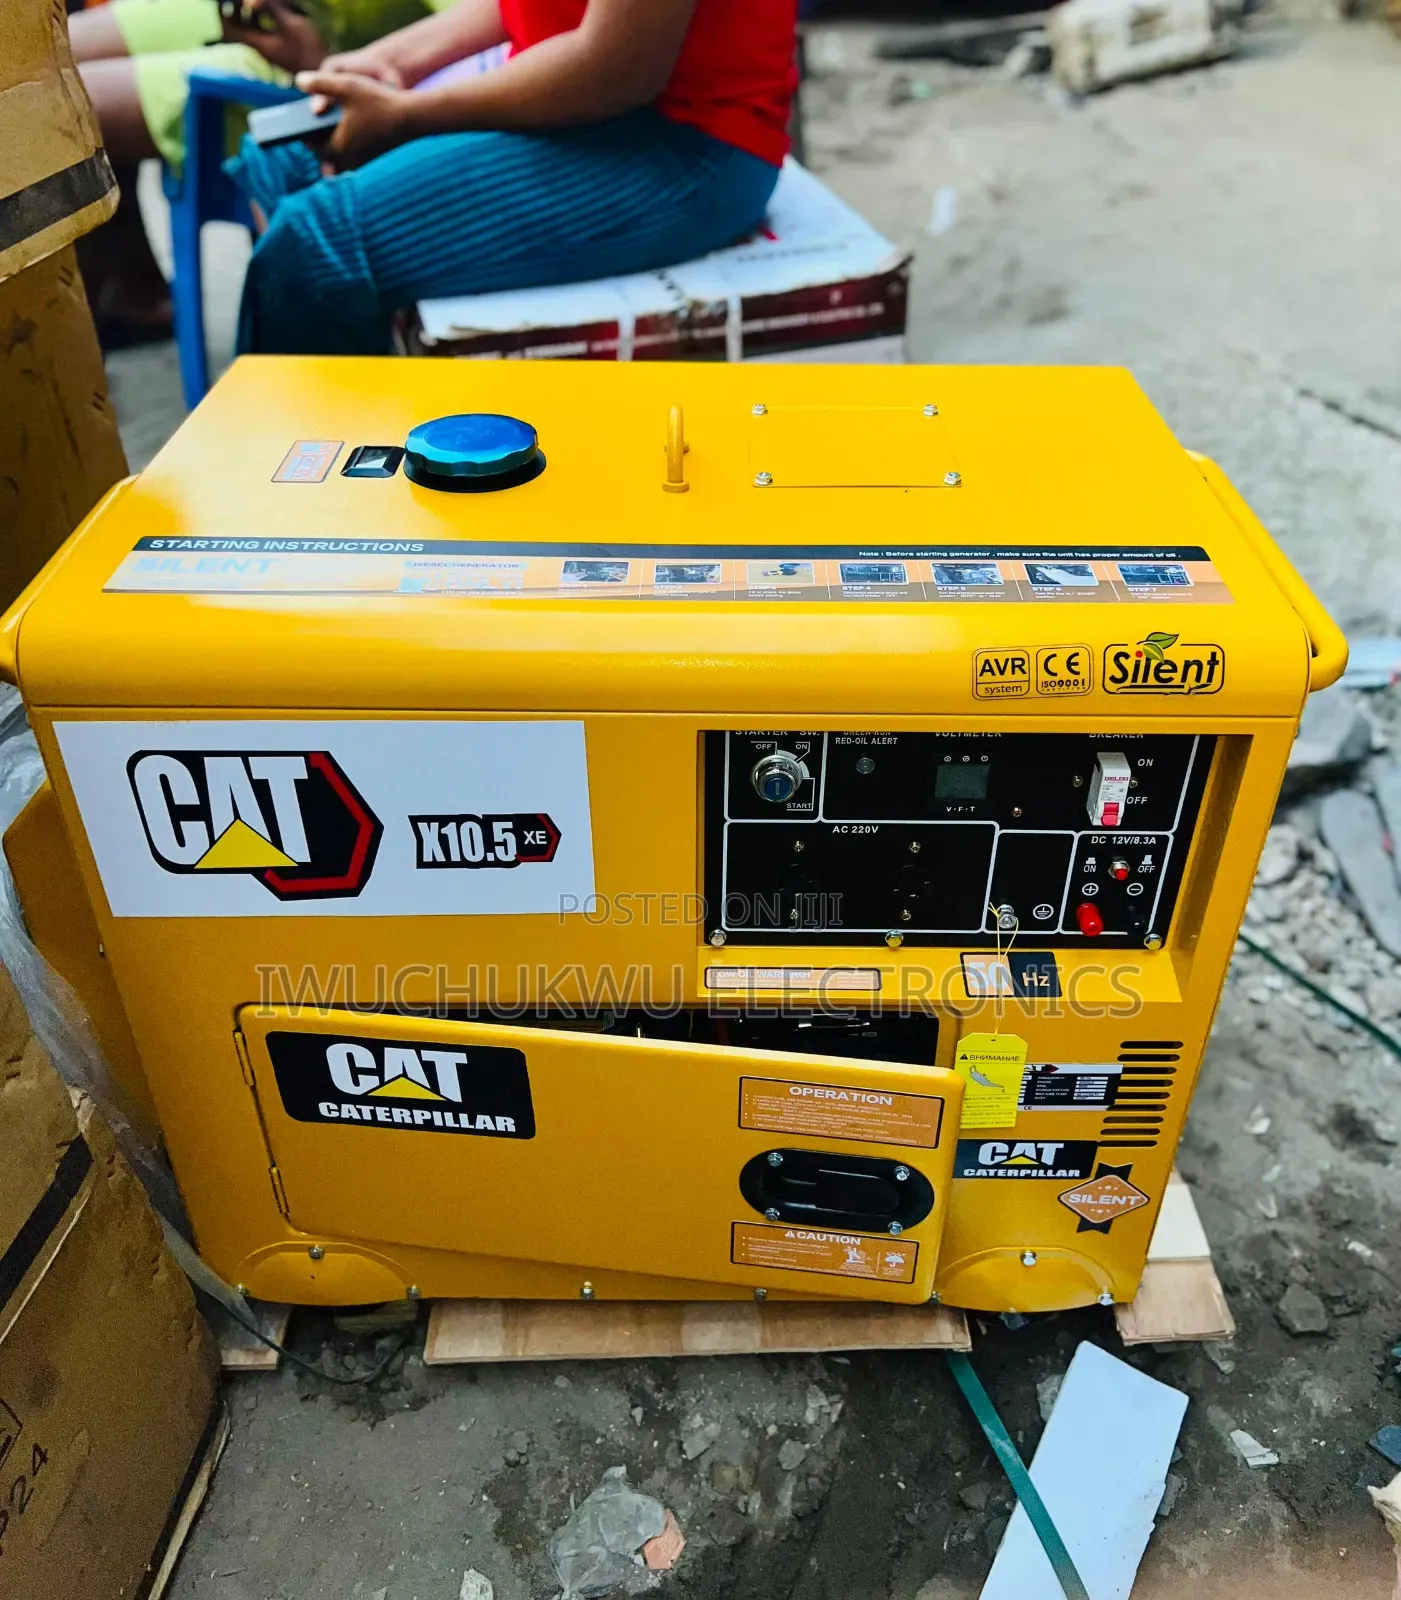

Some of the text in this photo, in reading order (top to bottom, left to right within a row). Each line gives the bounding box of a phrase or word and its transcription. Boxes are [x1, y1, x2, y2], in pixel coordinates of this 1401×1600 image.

[149, 538, 425, 553] STARTING INSTRUCTIONS
[134, 556, 281, 574] SILENT
[979, 657, 1027, 677] AVR
[1109, 650, 1219, 684] Silent
[985, 685, 1022, 695] system
[1041, 678, 1085, 688] ISO9001
[835, 737, 898, 745] RED-OIL ALERT
[1137, 758, 1153, 767] ON
[1126, 796, 1148, 805] OFF
[133, 754, 312, 865] CAT
[832, 825, 879, 834] AC 220V
[417, 821, 547, 863] X10.5 XE
[1091, 836, 1157, 845] DC 12V/8.3A
[1083, 864, 1097, 873] ON
[1137, 865, 1156, 873] OFF
[1022, 972, 1051, 987] Hz
[325, 1042, 468, 1103] CAT
[789, 1086, 893, 1106] OPERATION
[318, 1102, 516, 1132] CATERPILLAR
[978, 1141, 1065, 1166] CAT
[963, 1168, 1081, 1177] CATERPILLAR
[1068, 1193, 1141, 1206] SILENT
[796, 1231, 862, 1246] CAUTION
